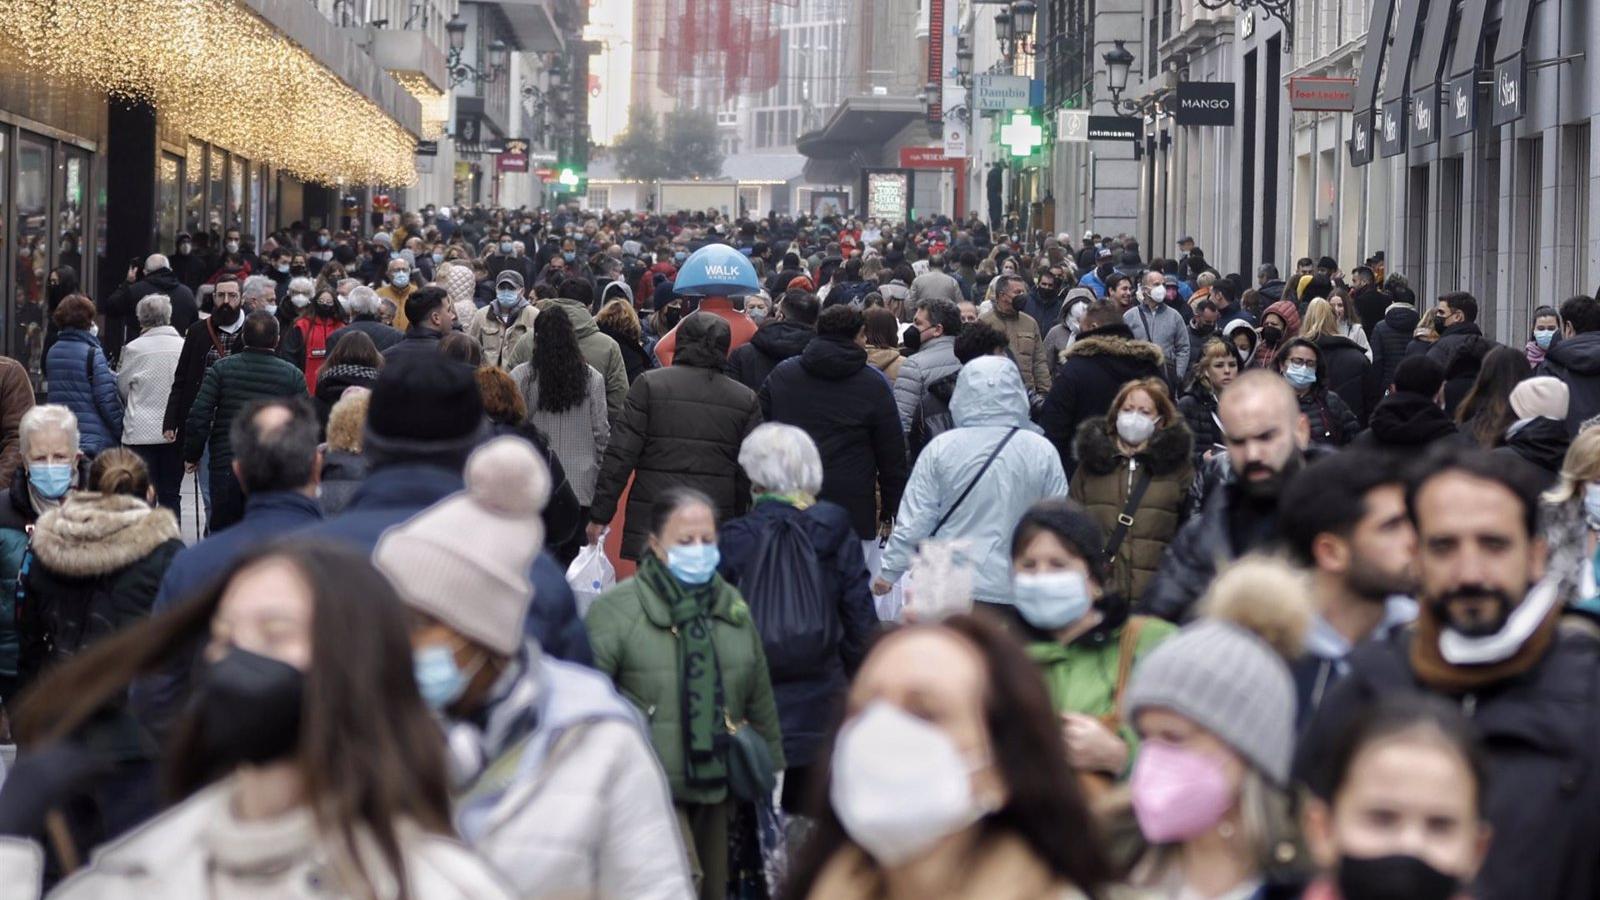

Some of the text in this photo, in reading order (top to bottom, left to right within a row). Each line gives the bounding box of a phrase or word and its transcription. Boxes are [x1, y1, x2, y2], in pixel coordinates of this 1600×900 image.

[980, 77, 992, 86] El
[980, 87, 1026, 97] Danubio
[980, 98, 1006, 108] Azul
[1181, 99, 1230, 109] MANGO
[704, 264, 740, 276] WALK
